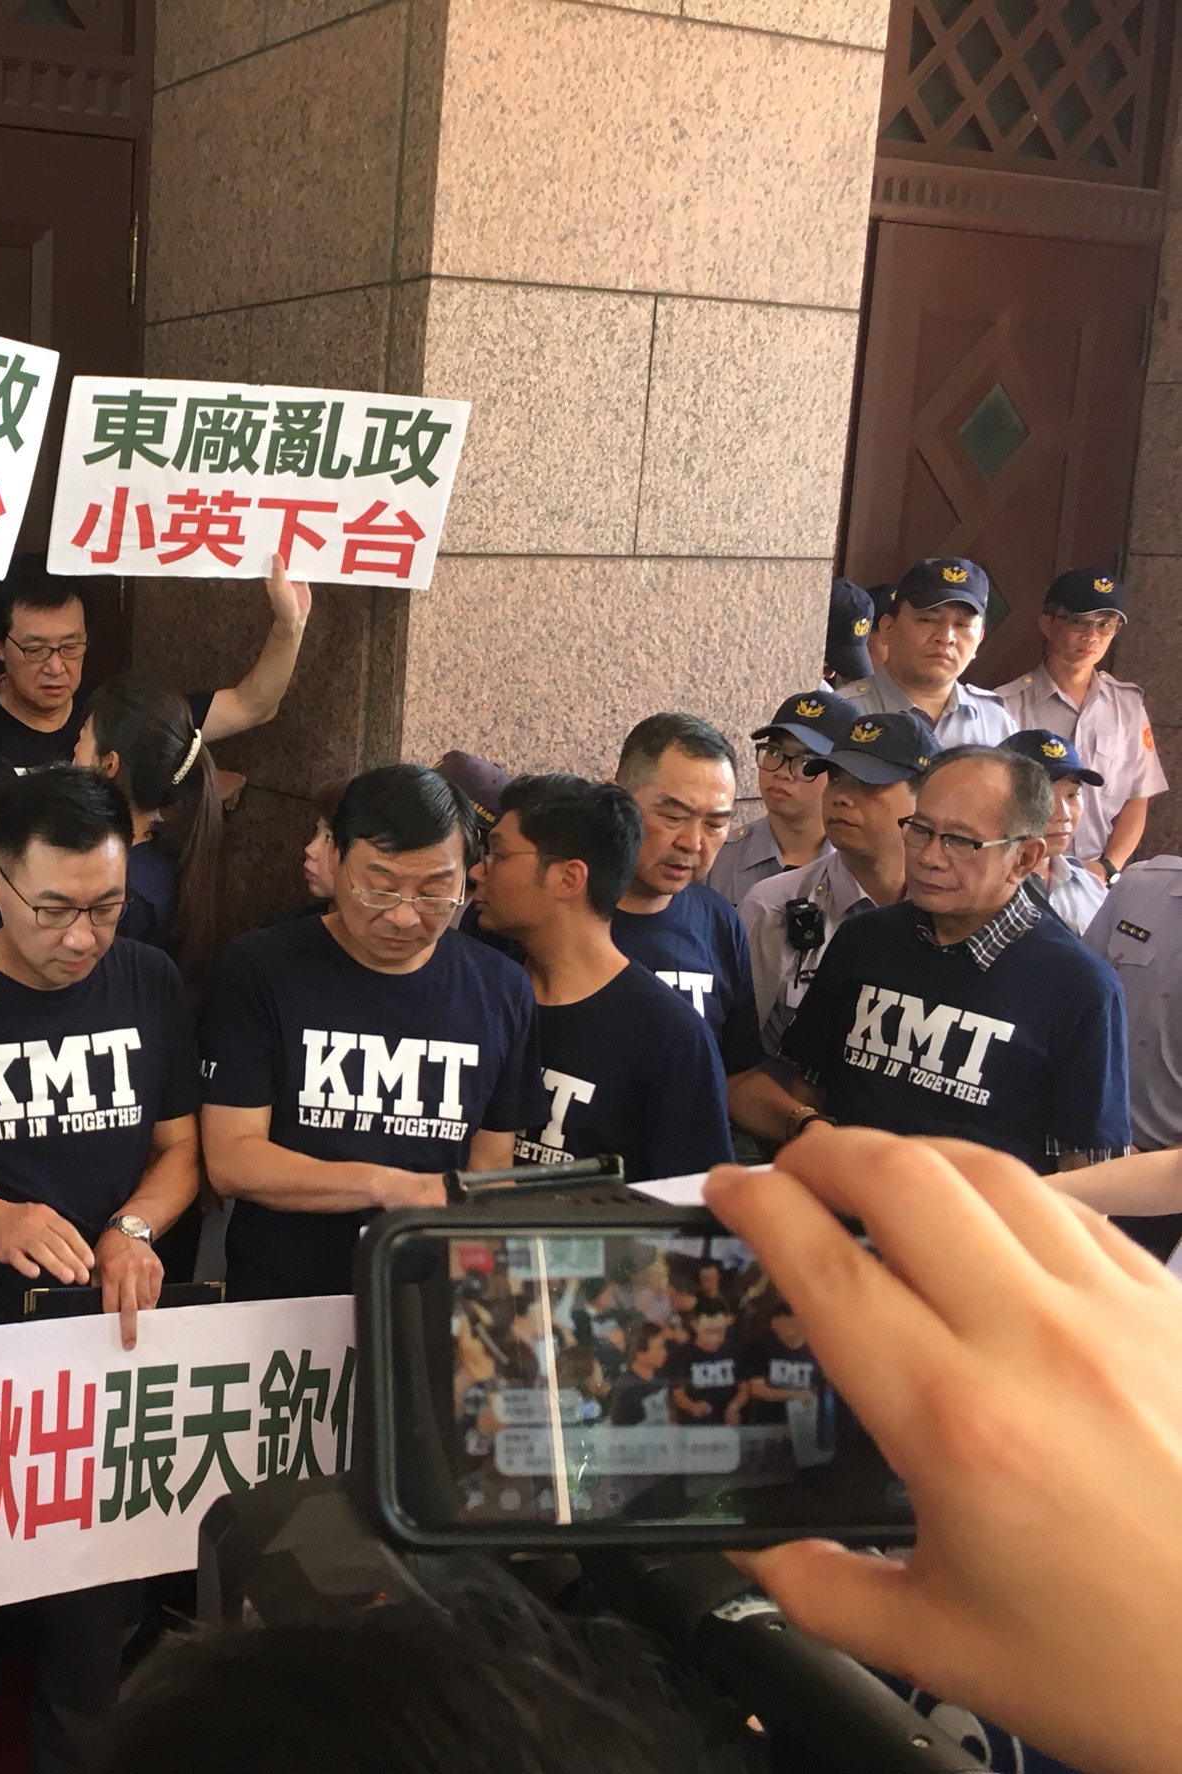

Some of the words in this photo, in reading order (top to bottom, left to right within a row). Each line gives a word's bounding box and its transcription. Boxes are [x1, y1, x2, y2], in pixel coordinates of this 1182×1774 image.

[83, 389, 452, 486] 東廠亂政
[71, 486, 426, 578] 小英下台
[298, 1028, 479, 1120] KMT
[843, 1046, 880, 1071] LEAN
[883, 1059, 903, 1078] IN
[907, 1066, 991, 1106] TOGETHER
[846, 984, 1016, 1086] KMT
[28, 1117, 48, 1138] IN
[298, 1107, 345, 1129] LEAN
[353, 1112, 373, 1132] IN
